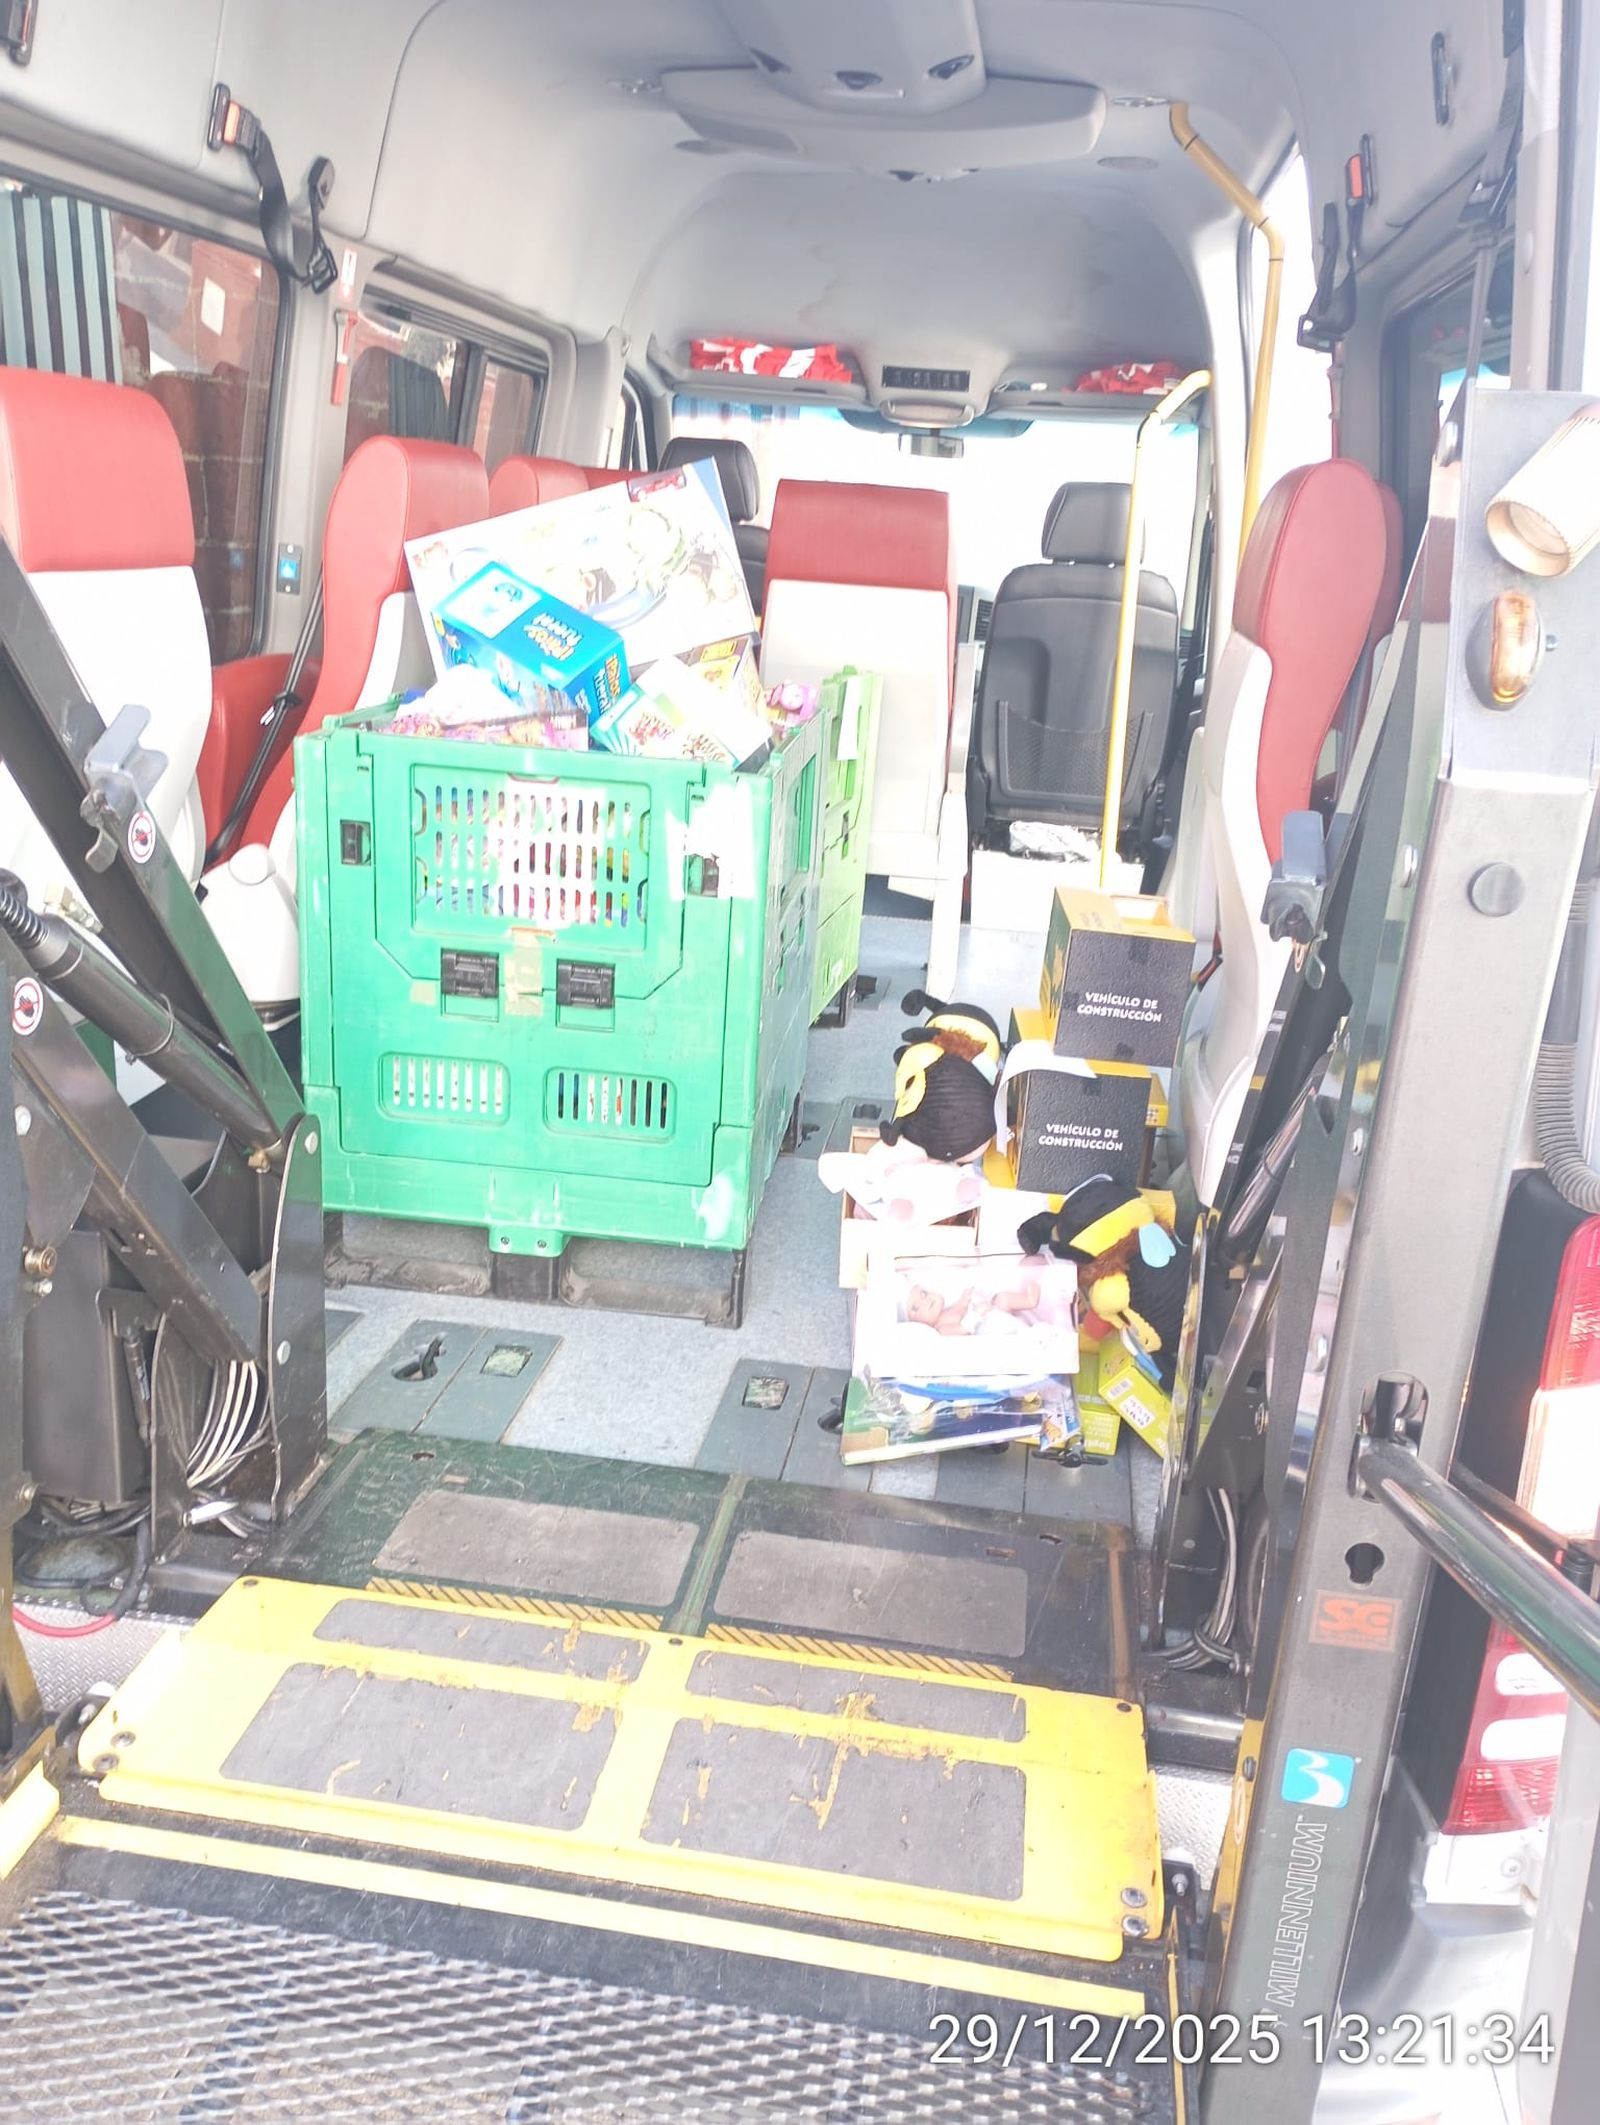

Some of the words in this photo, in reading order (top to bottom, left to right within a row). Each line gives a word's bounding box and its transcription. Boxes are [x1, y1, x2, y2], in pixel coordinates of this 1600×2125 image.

[1084, 991, 1141, 1007] VEHÍCULO
[1142, 998, 1159, 1010] DE
[1077, 1004, 1162, 1023] CONSTRUCCIÓN
[1046, 1122, 1102, 1139] VEHÍCULO
[1103, 1128, 1119, 1140] DE
[1038, 1135, 1123, 1151] CONSTRUCCIÓN
[1265, 1822, 1328, 2008] MILLENNIUM
